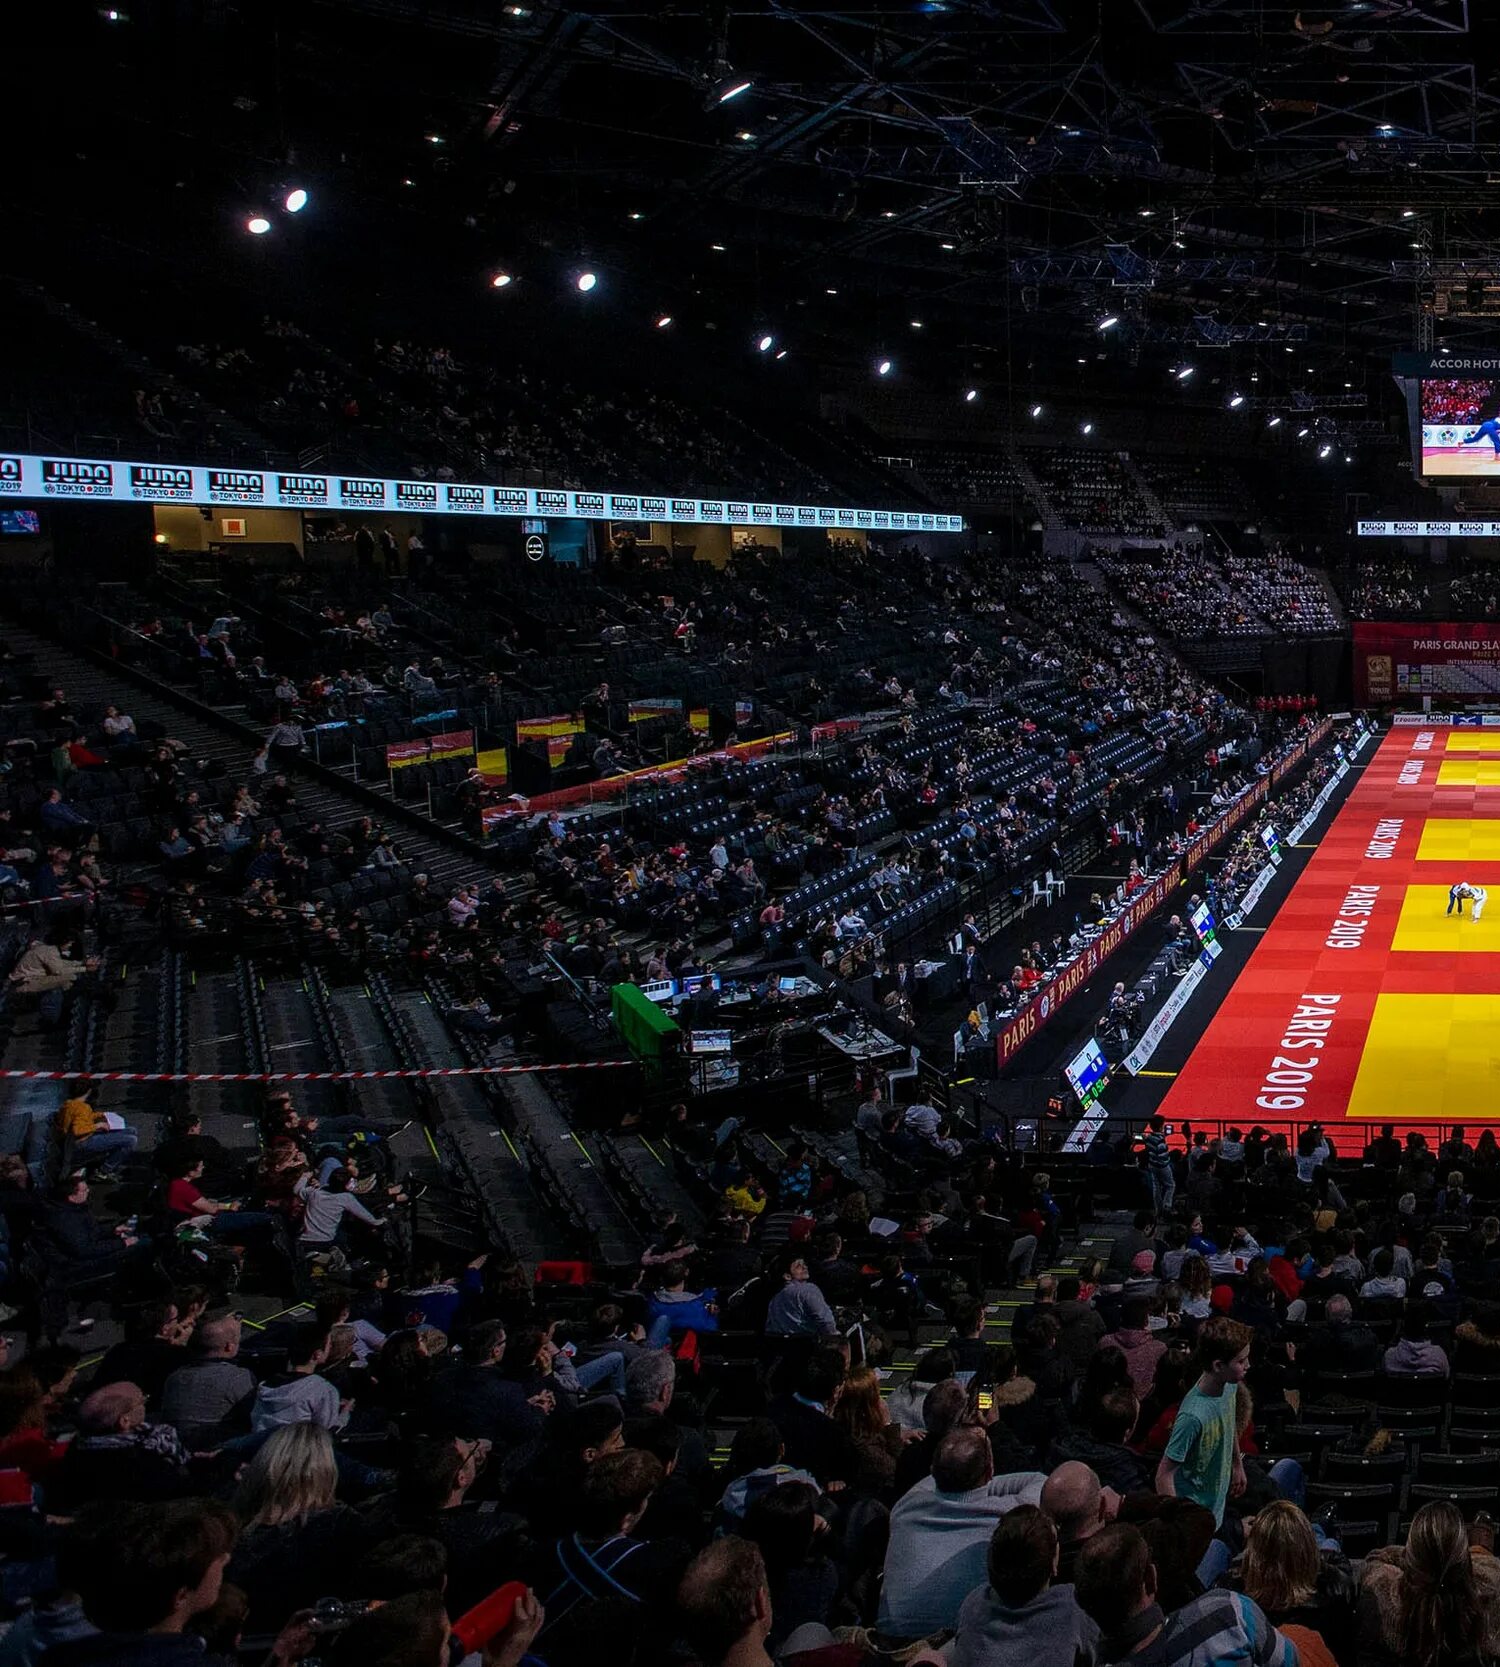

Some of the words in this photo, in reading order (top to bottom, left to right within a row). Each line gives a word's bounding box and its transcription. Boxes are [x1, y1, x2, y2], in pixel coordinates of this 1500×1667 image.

[1430, 359, 1471, 369] ACCOR
[47, 463, 109, 484] JUDO
[134, 468, 189, 488] JUDO
[212, 473, 261, 491] JUDO
[56, 484, 85, 493] TOKYO
[93, 486, 112, 494] 2019
[143, 488, 169, 496] TOKYO
[280, 478, 325, 495] JUDO
[343, 481, 383, 498] JUDO
[399, 485, 434, 500] JUDO
[449, 487, 482, 503] JUDO
[495, 490, 526, 505] JUDO
[1413, 640, 1441, 650] PARIS
[1443, 641, 1480, 650] GRAND
[1370, 687, 1390, 695] TOUR
[1373, 818, 1404, 839] PARIS
[1364, 840, 1397, 859] 2019
[1136, 892, 1154, 924] PARIS
[1339, 885, 1381, 916] PARIS
[1100, 924, 1121, 960] PARIS
[1325, 919, 1368, 949] 2019
[1058, 960, 1084, 1002] PARIS
[1280, 994, 1342, 1049] PARIS
[1003, 1008, 1036, 1057] PARIS
[1256, 1056, 1320, 1110] 2019
